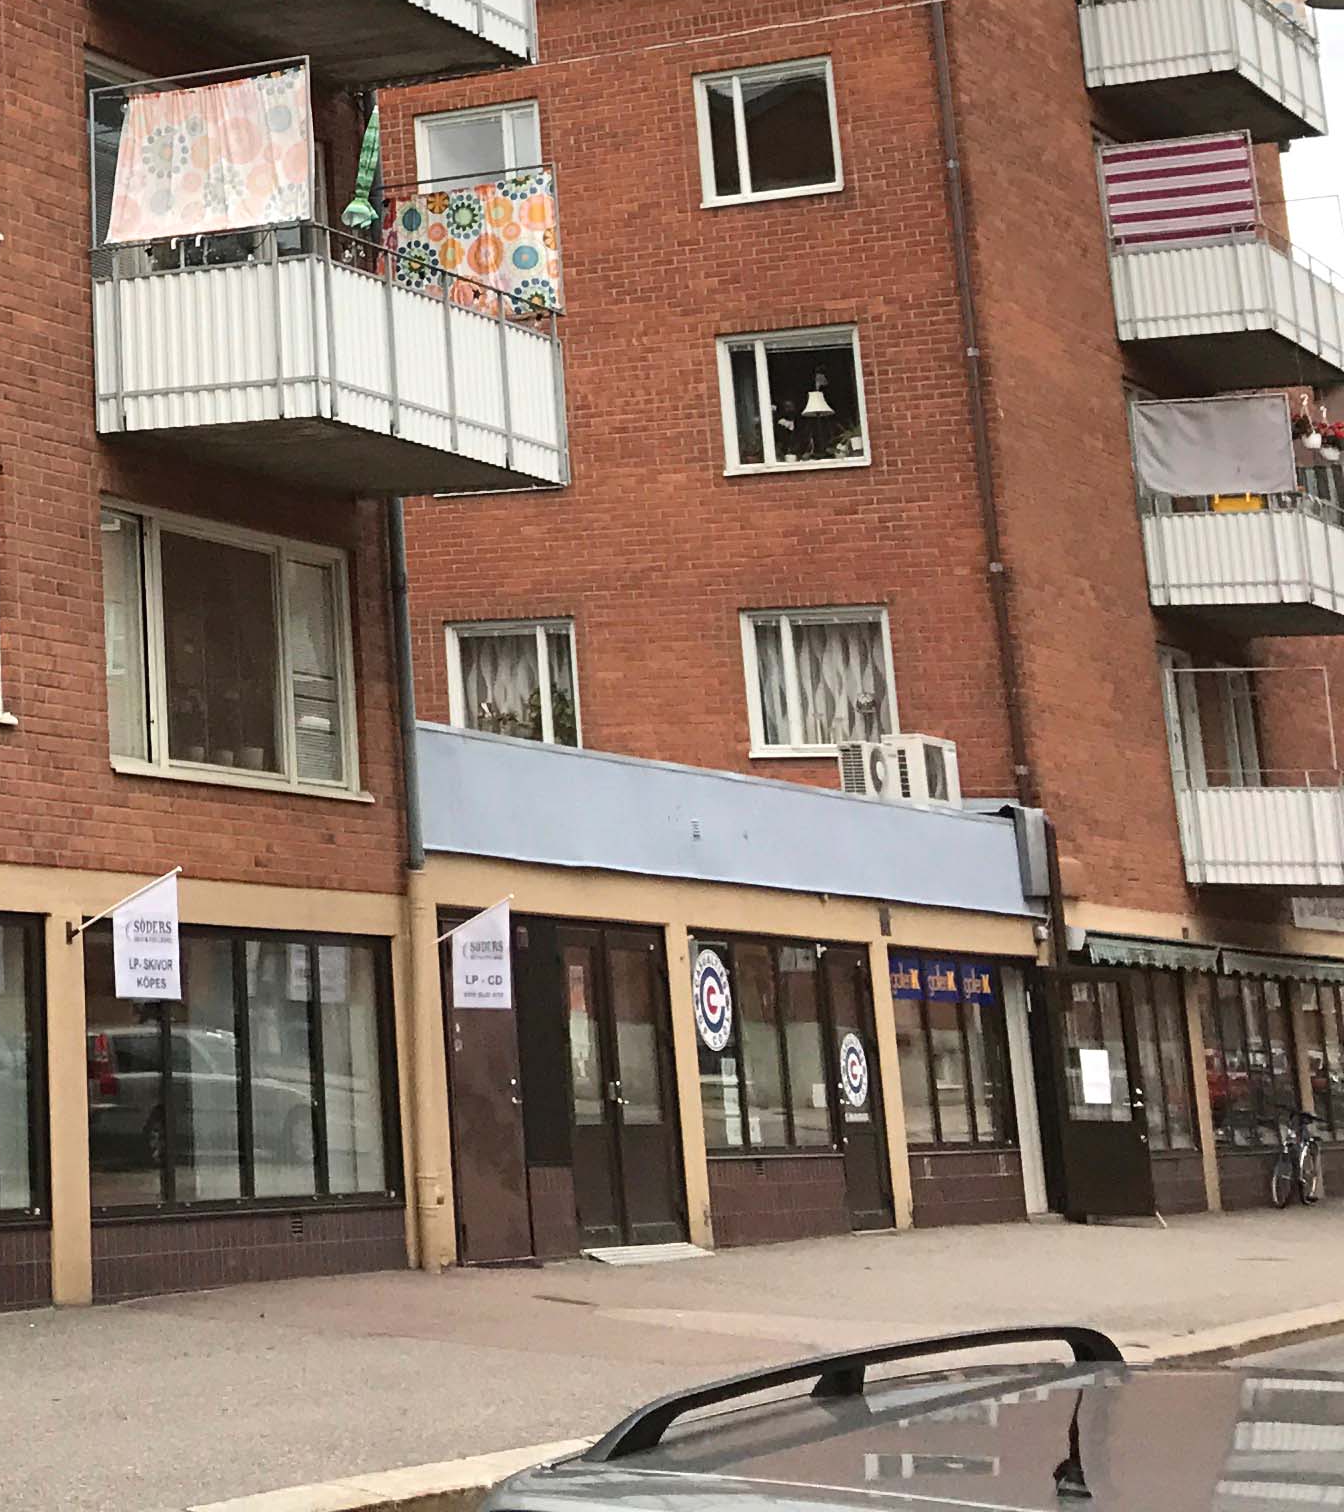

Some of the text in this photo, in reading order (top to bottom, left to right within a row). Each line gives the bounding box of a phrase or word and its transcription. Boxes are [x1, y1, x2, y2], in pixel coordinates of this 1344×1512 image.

[136, 976, 167, 989] KÖPES
[465, 975, 479, 985] LP
[487, 975, 503, 985] CD
